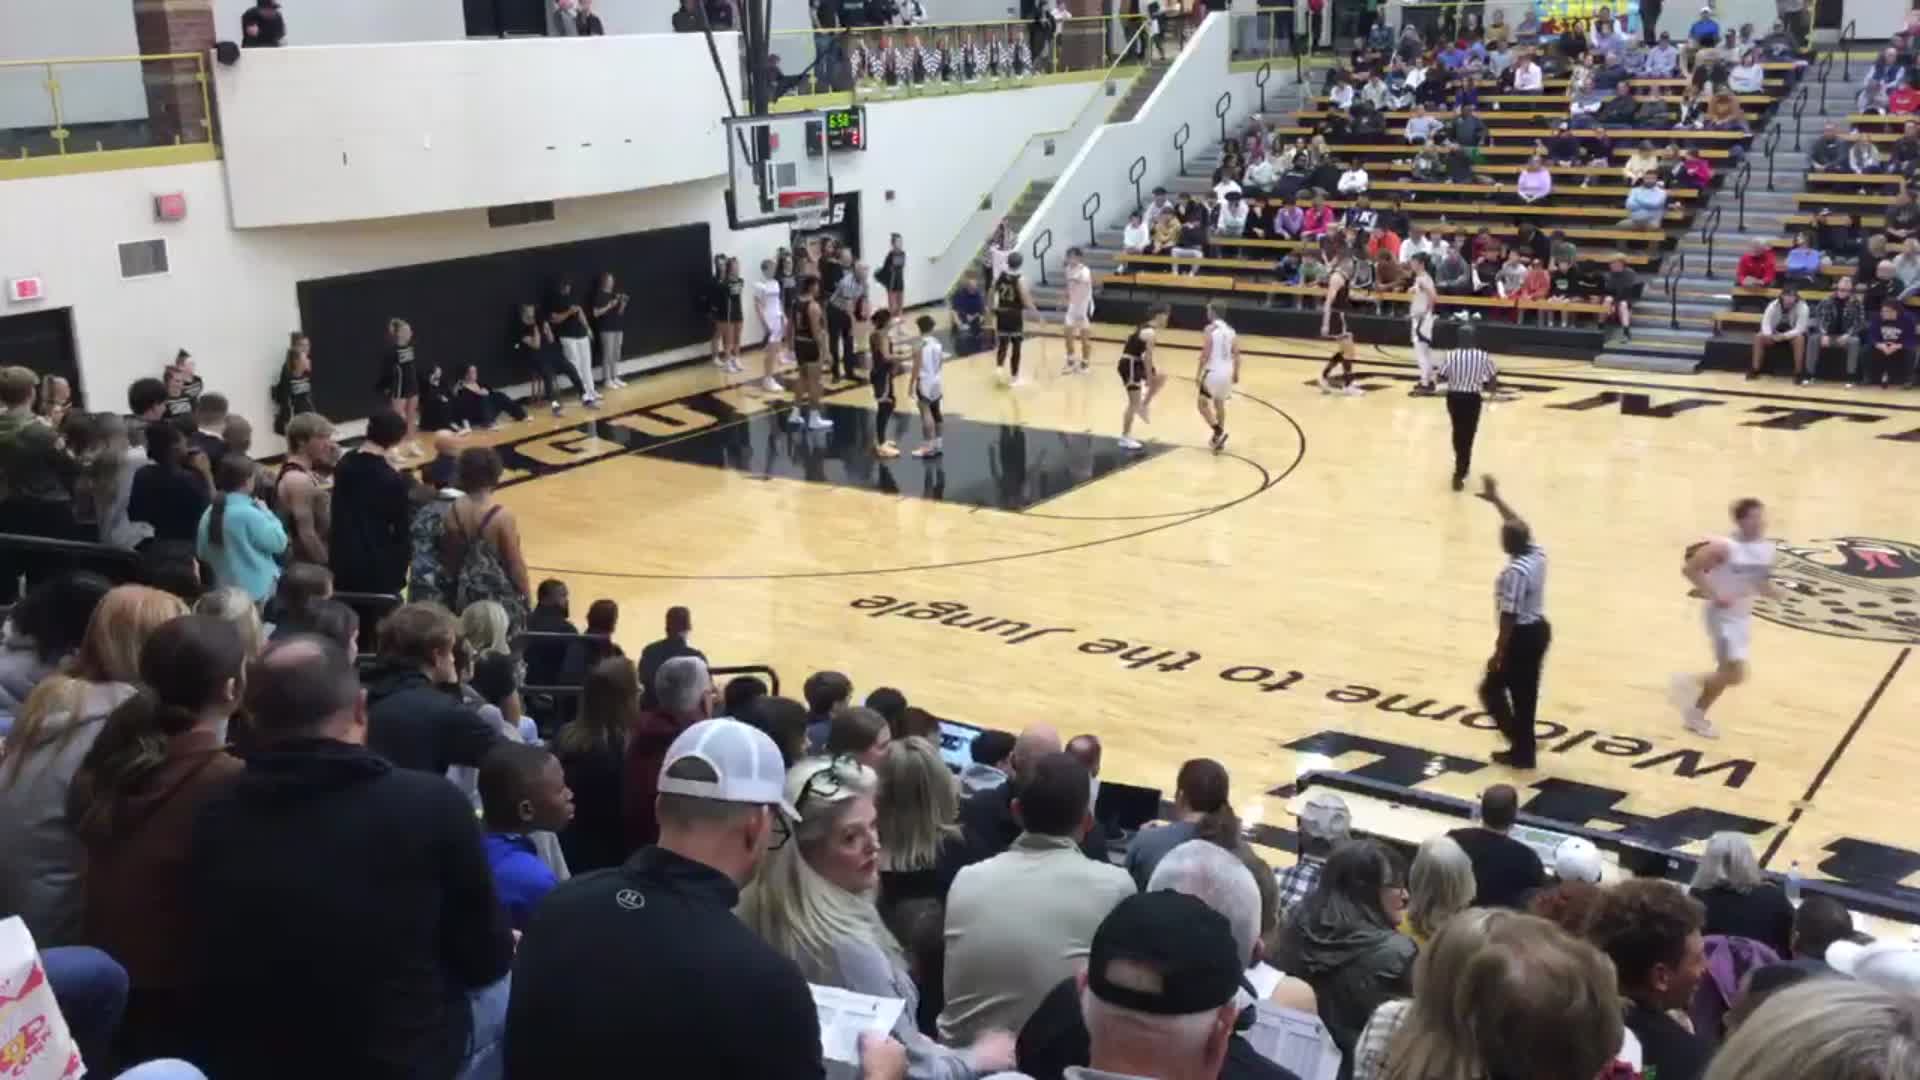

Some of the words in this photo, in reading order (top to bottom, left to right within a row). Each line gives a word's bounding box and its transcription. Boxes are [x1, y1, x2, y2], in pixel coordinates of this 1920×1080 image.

[850, 594, 1076, 644] Jungle
[1078, 638, 1201, 672] the
[1219, 665, 1304, 692] to
[1325, 684, 1757, 790] Welcome
